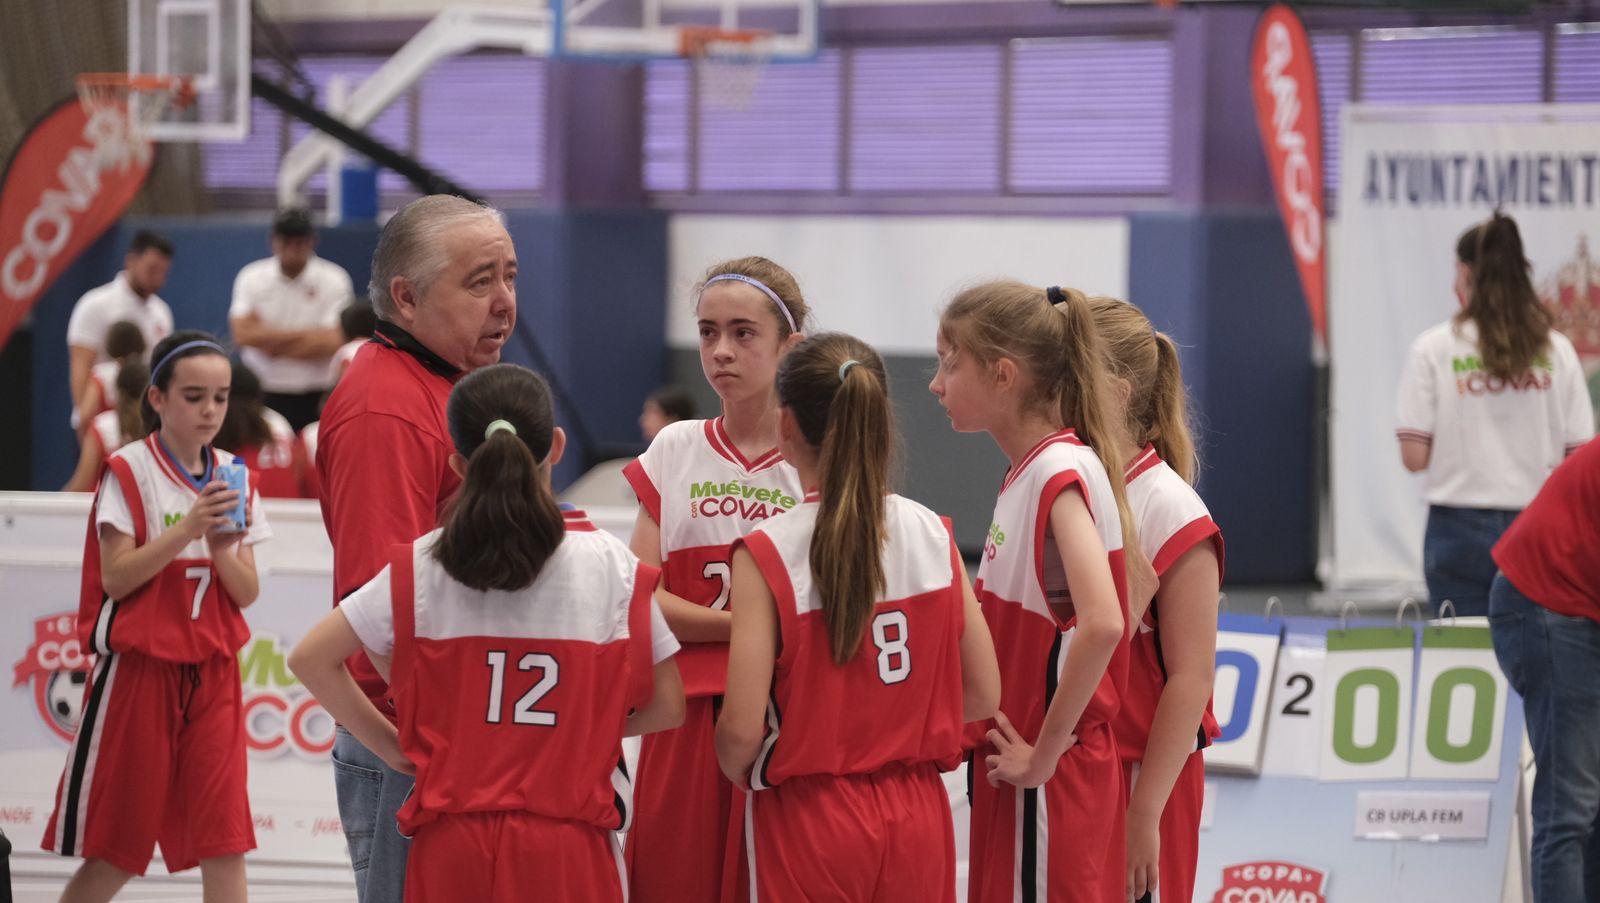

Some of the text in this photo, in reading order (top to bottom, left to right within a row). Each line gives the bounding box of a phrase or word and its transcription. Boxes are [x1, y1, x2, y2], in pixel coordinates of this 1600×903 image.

[690, 480, 796, 509] Muévete
[185, 566, 211, 620] 7
[871, 609, 912, 686] 8
[485, 650, 561, 727] 12
[1281, 672, 1314, 716] 2
[1389, 808, 1428, 824] UPLA
[1431, 808, 1464, 825] FEM
[1241, 864, 1303, 883] COPA
